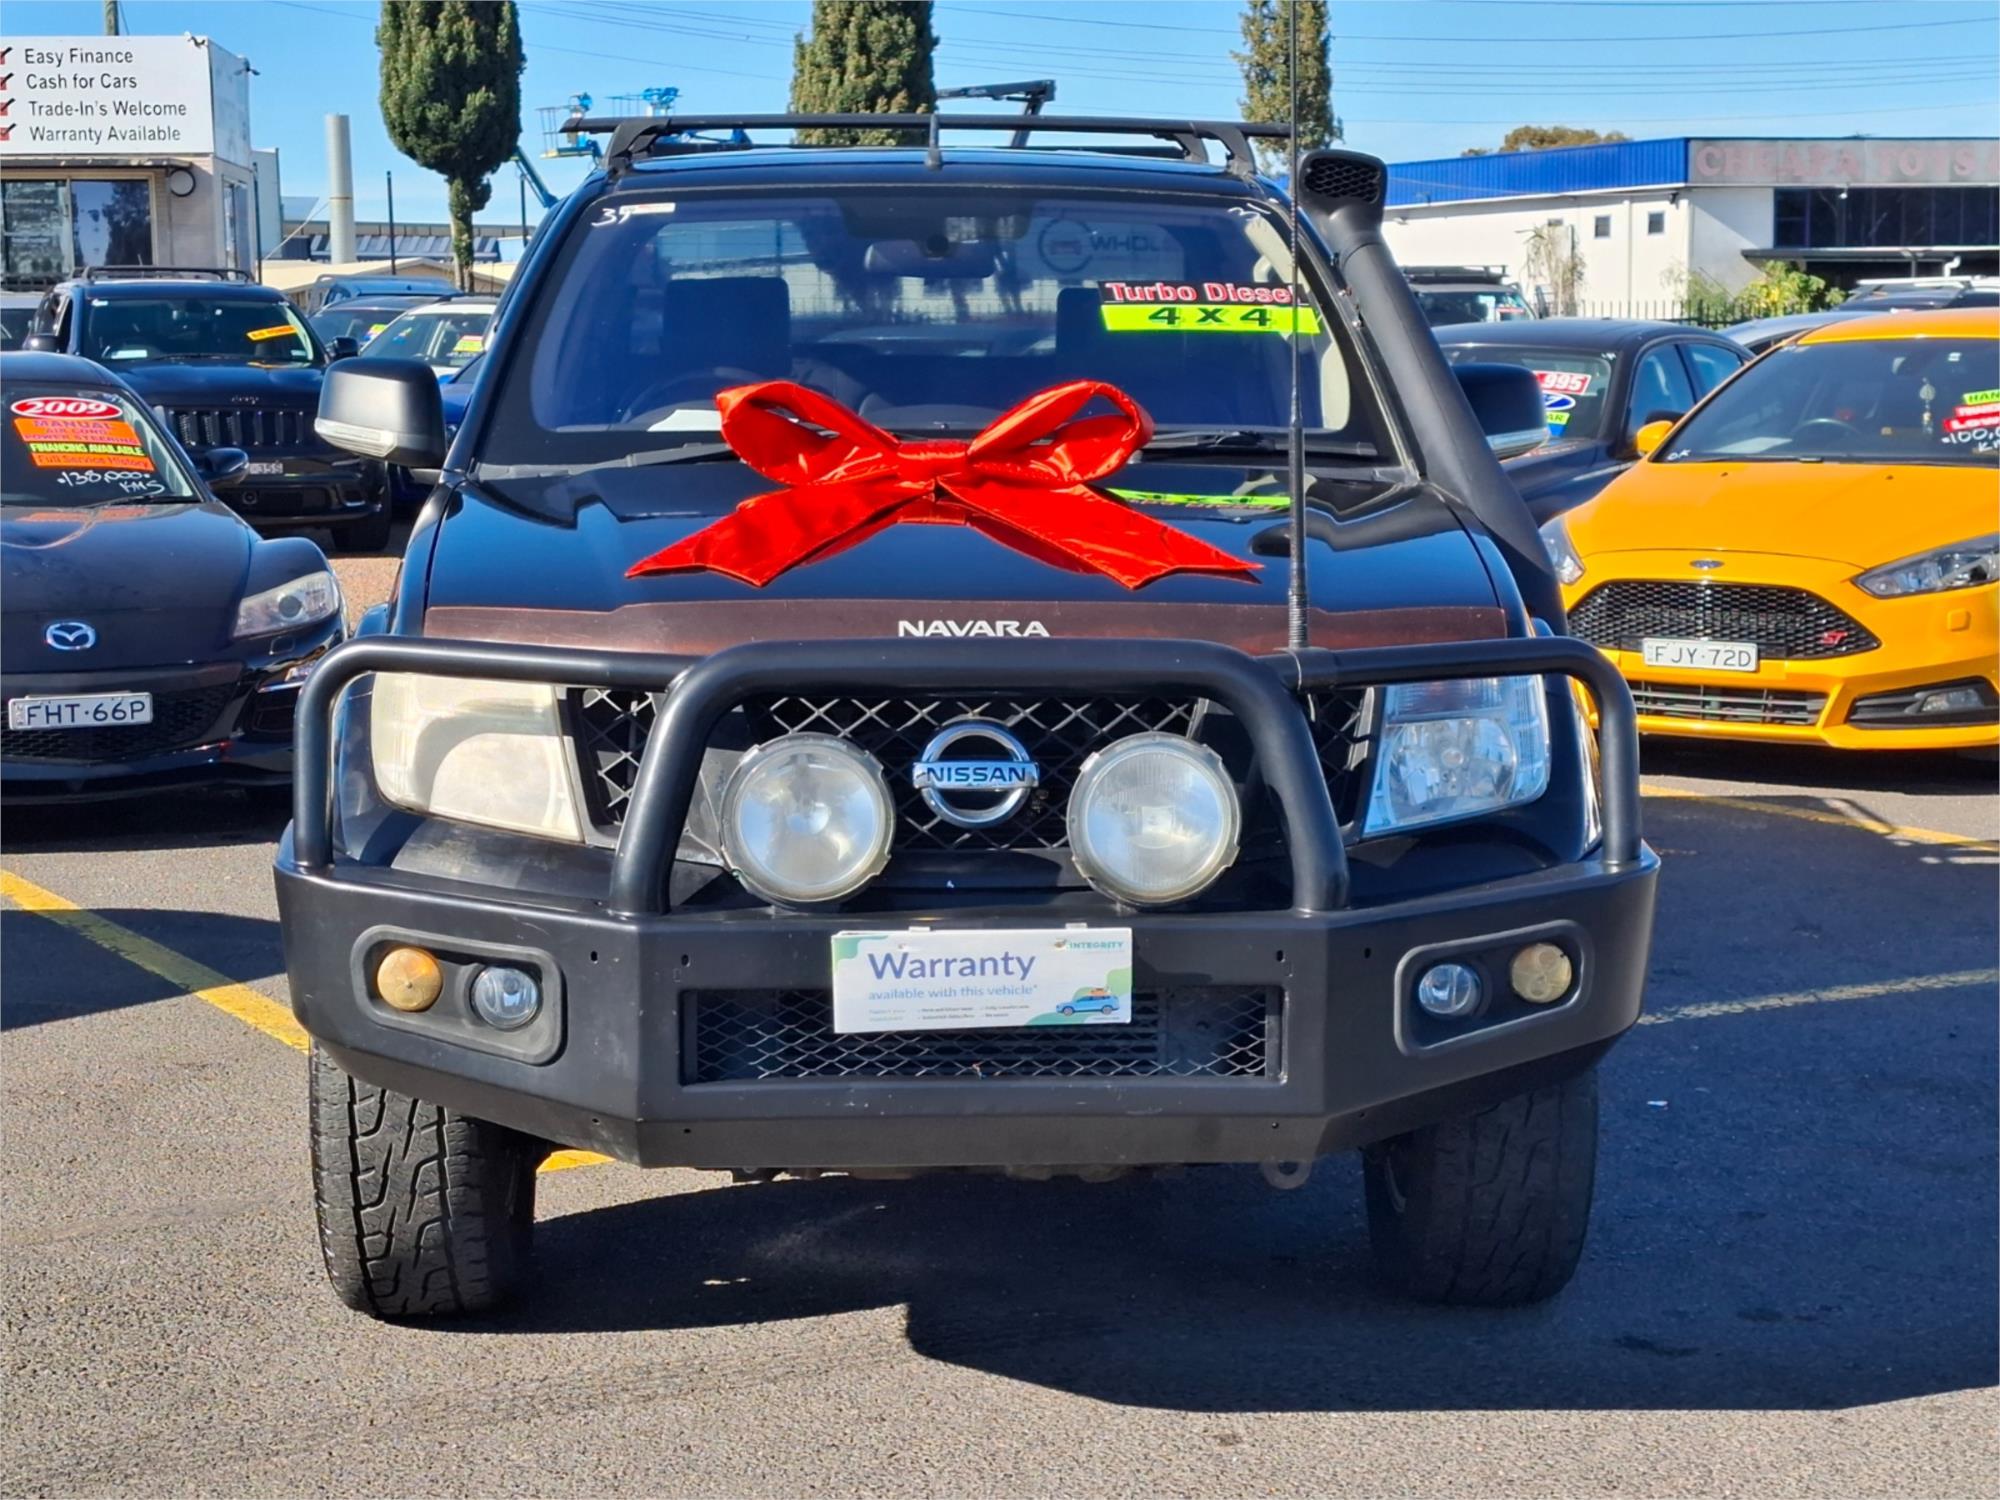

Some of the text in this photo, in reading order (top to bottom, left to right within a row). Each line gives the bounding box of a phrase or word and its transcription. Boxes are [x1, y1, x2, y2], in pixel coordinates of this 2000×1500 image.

[24, 48, 134, 67] Easy Finance
[26, 73, 138, 90] Cash for Cars
[28, 101, 187, 117] Trade-In's Welcome
[29, 126, 181, 145] Warranty Available
[1105, 282, 1198, 302] Turbo
[1148, 306, 1181, 325] 4
[1240, 308, 1271, 327] 4
[24, 401, 108, 415] 2009
[34, 420, 113, 430] MANUAL
[30, 443, 146, 456] FINANCING AVAILABLE
[38, 455, 149, 468] Full Service History
[898, 620, 1050, 638] NAVARA
[927, 767, 1026, 782] NISSAN
[867, 950, 1036, 980] Warranty
[868, 986, 925, 1001] available
[928, 986, 957, 998] with
[960, 985, 984, 998] this
